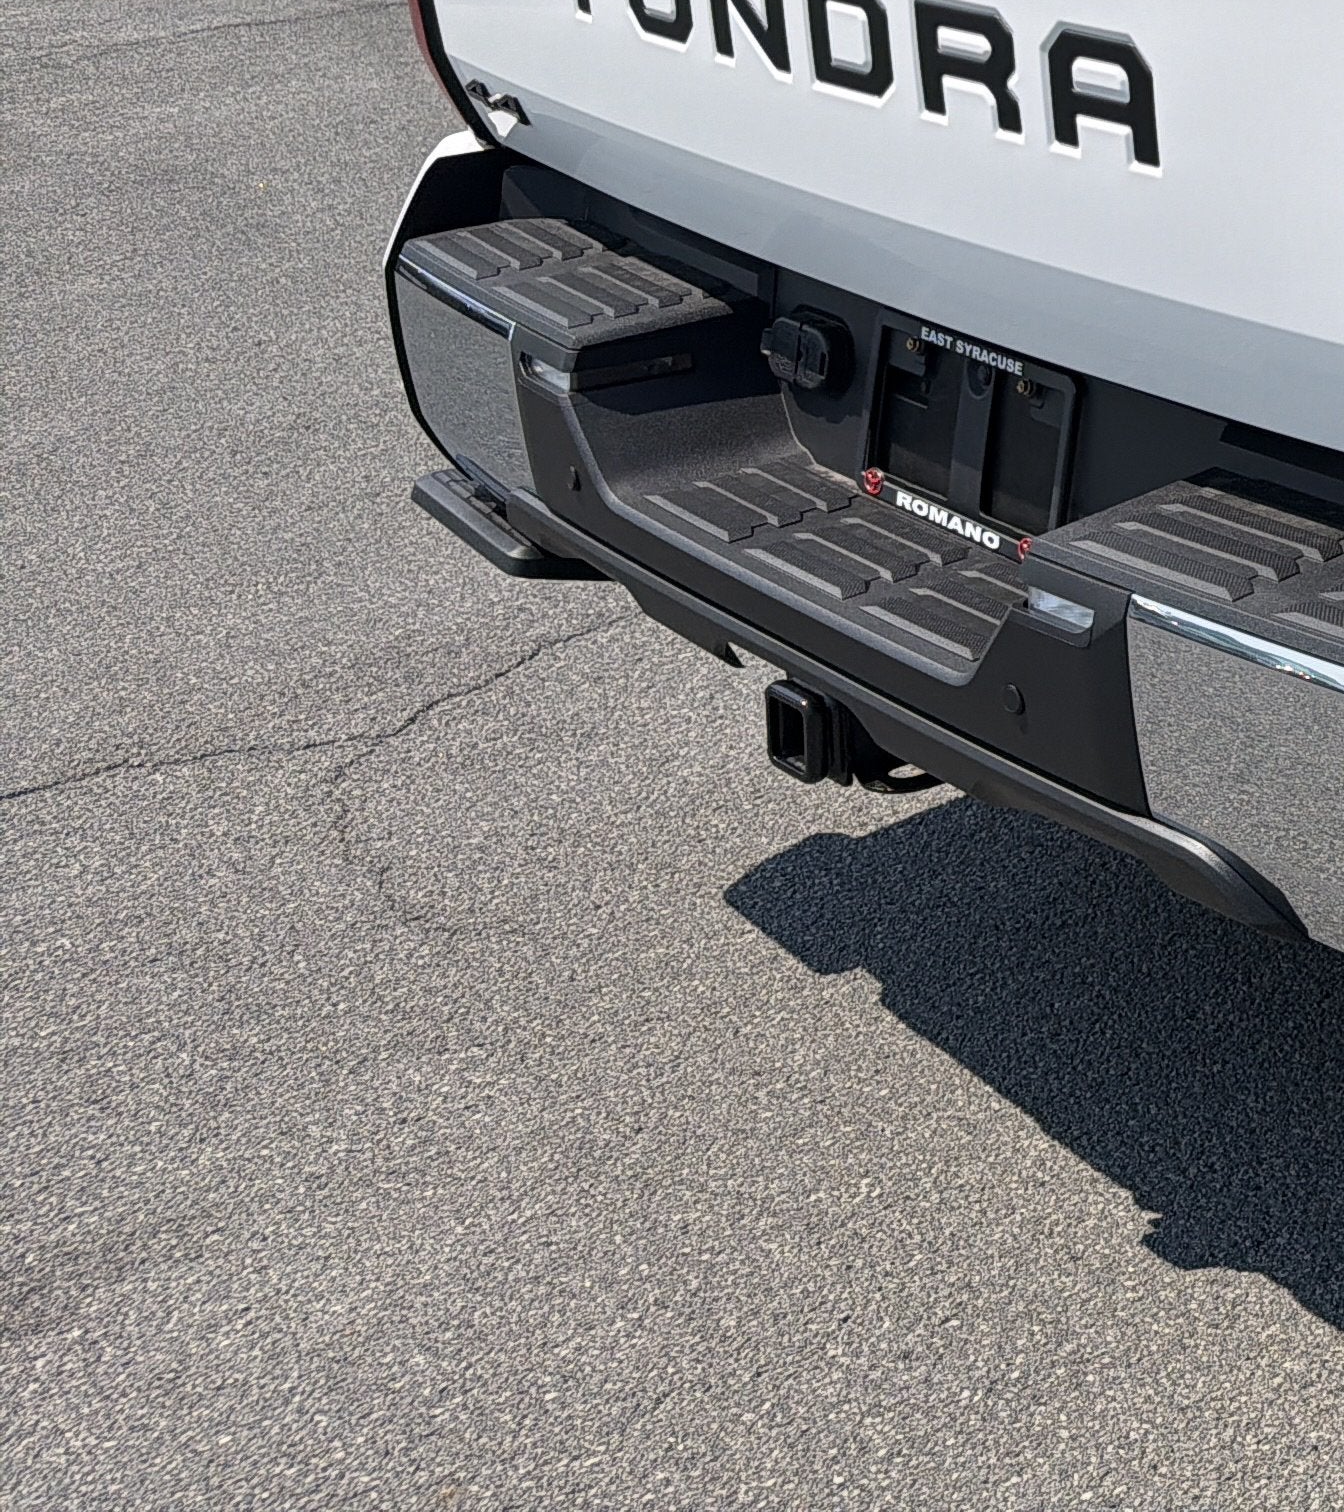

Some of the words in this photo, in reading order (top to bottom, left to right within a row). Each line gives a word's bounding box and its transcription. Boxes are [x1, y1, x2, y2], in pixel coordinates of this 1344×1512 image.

[920, 326, 953, 349] EAST
[955, 340, 1024, 376] SYRACUSE
[895, 489, 1001, 551] ROMANO
